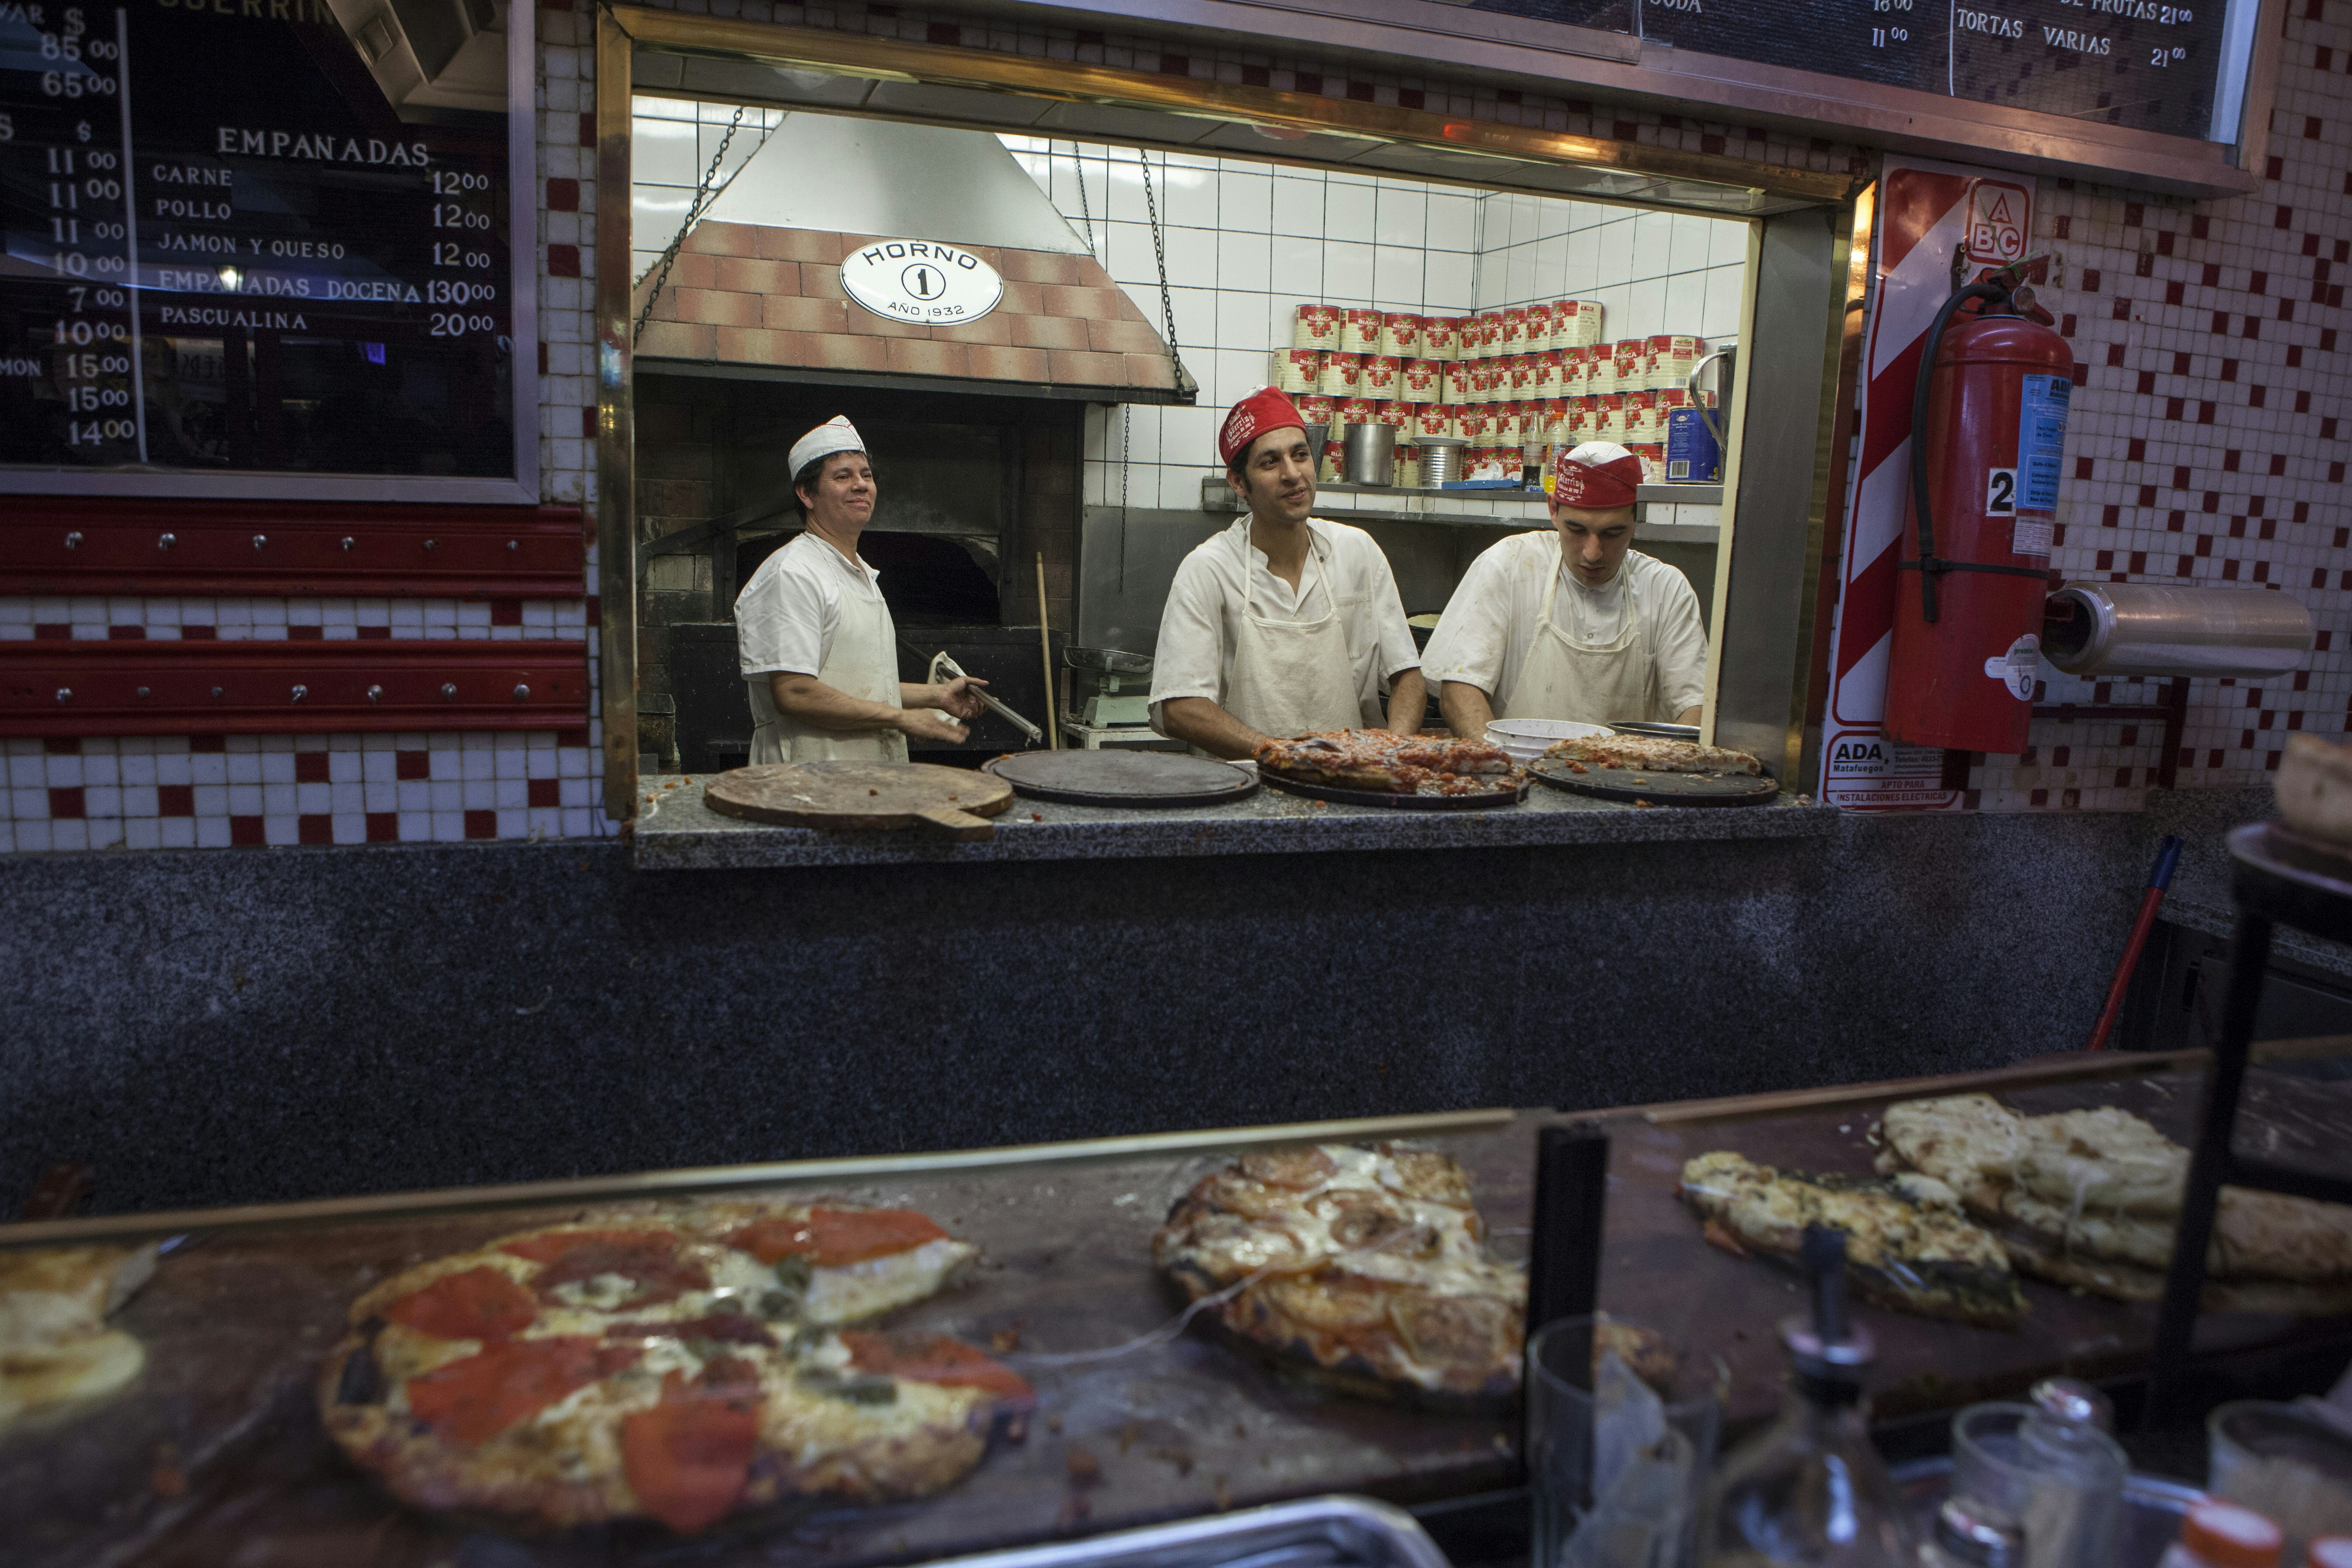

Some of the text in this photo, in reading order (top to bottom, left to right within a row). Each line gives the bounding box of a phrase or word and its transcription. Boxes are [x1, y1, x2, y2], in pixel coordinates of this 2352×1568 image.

[64, 7, 85, 36] $
[1958, 9, 2023, 39] TORTAS
[2043, 27, 2110, 55] VARIAS
[78, 121, 91, 142] $
[152, 164, 232, 186] CARNE
[156, 199, 231, 220] POLLO
[157, 233, 237, 253] JAMON
[250, 238, 263, 255] Y
[271, 239, 345, 260] QUESO
[862, 243, 978, 270] HORNO
[159, 271, 310, 296] EMPAADAS
[328, 280, 421, 303] DOCENA
[918, 268, 930, 295] 1
[162, 307, 307, 329] PASCUALINA
[888, 302, 964, 316] AÑO 1932
[1990, 472, 2014, 511] 2
[1835, 744, 1882, 760] ADA
[1833, 764, 1883, 773] Matafuegos
[1901, 792, 1947, 801] ELECTRICAS
